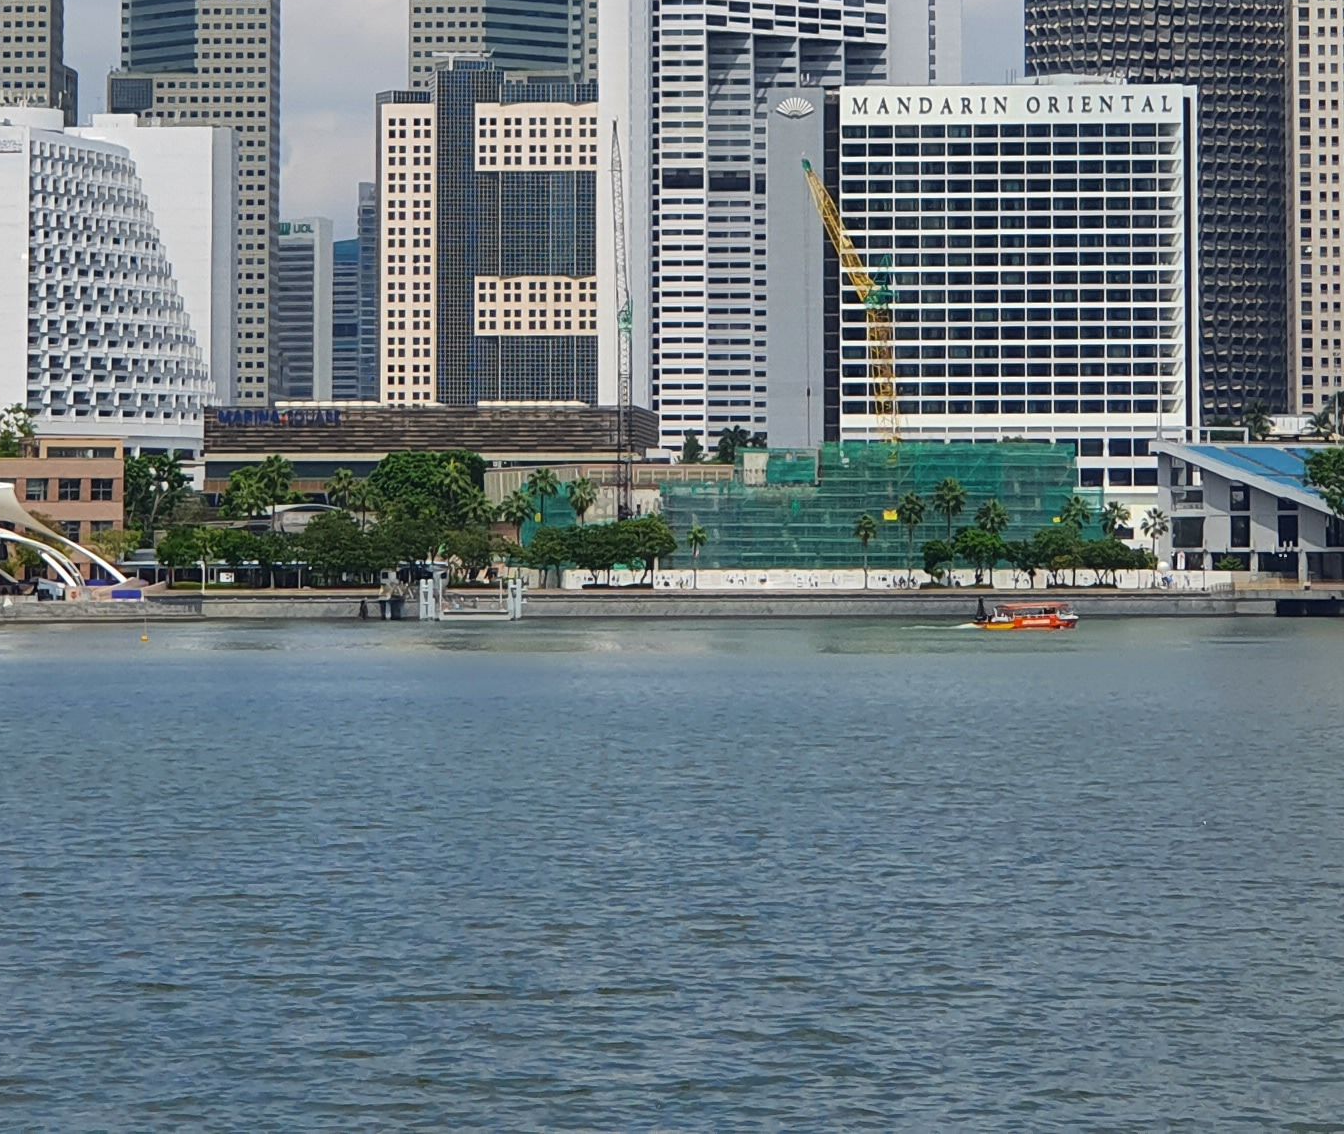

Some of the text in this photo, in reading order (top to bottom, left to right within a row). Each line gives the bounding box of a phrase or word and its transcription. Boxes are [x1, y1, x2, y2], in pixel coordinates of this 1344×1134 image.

[851, 95, 1173, 115] MANDARIN ORIENTAL
[217, 409, 281, 426] MARINA
